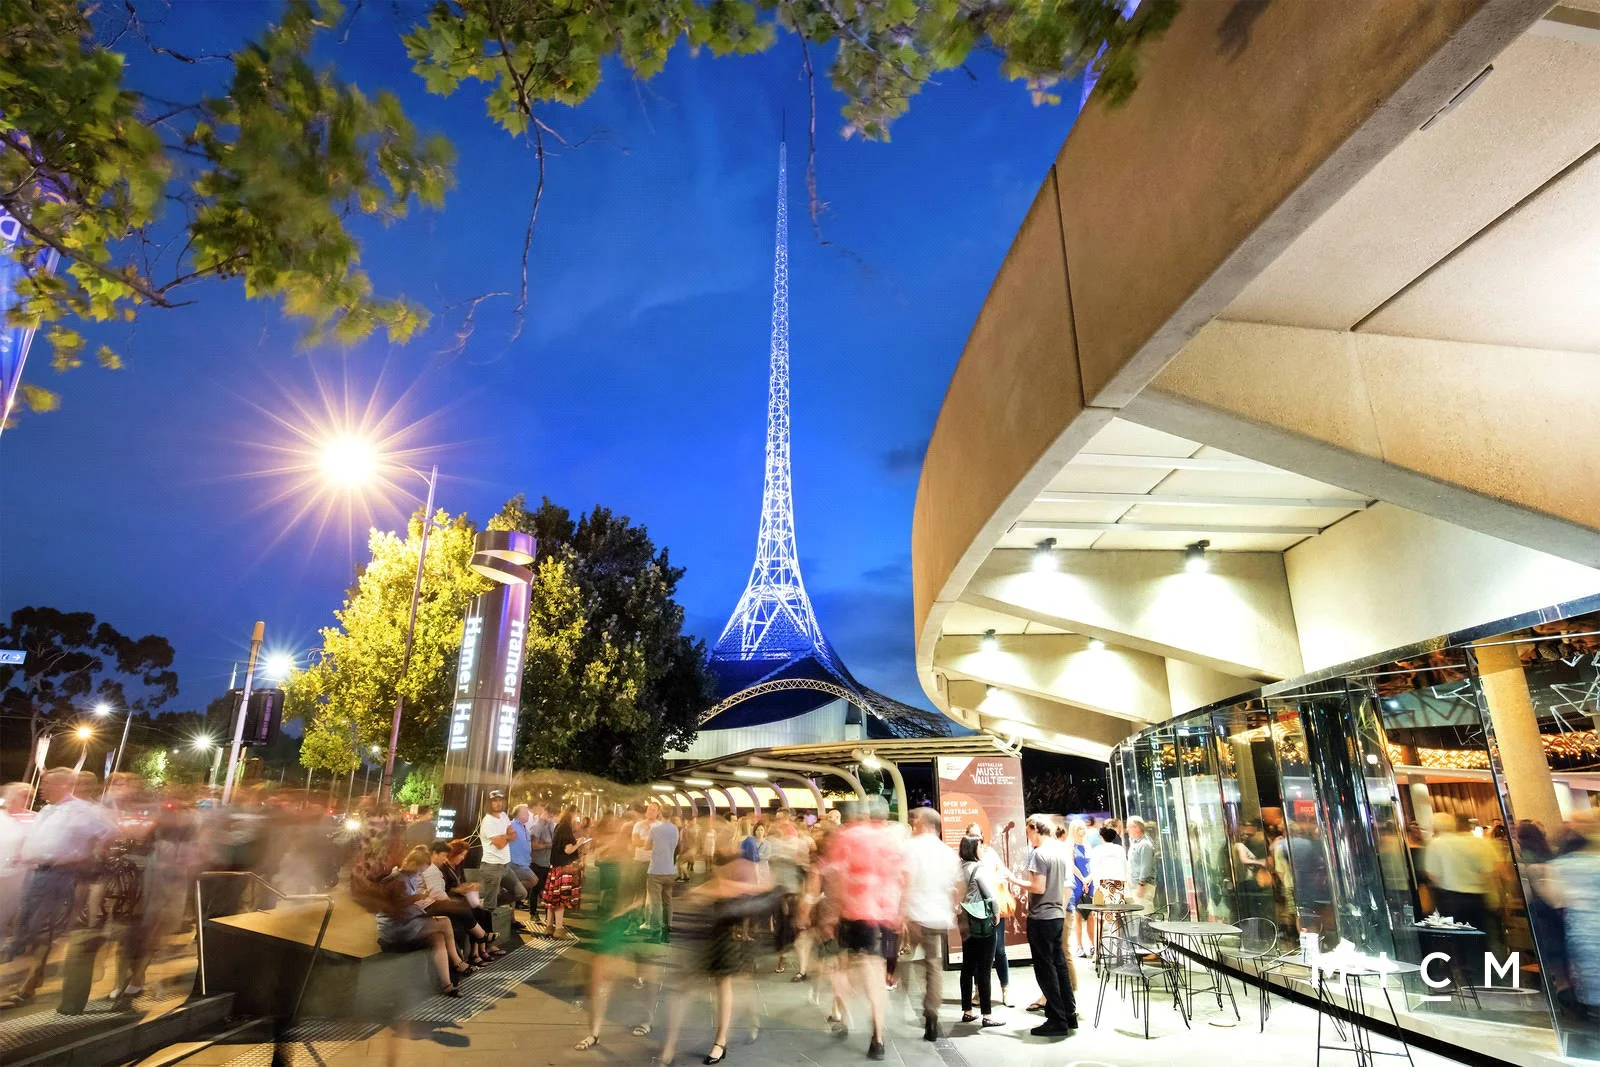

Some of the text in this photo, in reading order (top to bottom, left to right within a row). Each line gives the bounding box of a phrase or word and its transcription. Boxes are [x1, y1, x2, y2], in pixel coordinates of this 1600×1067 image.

[450, 616, 483, 750] Hamer Hall
[497, 705, 517, 752] Hall
[969, 774, 996, 785] VAULT
[976, 767, 1004, 776] MUSIC
